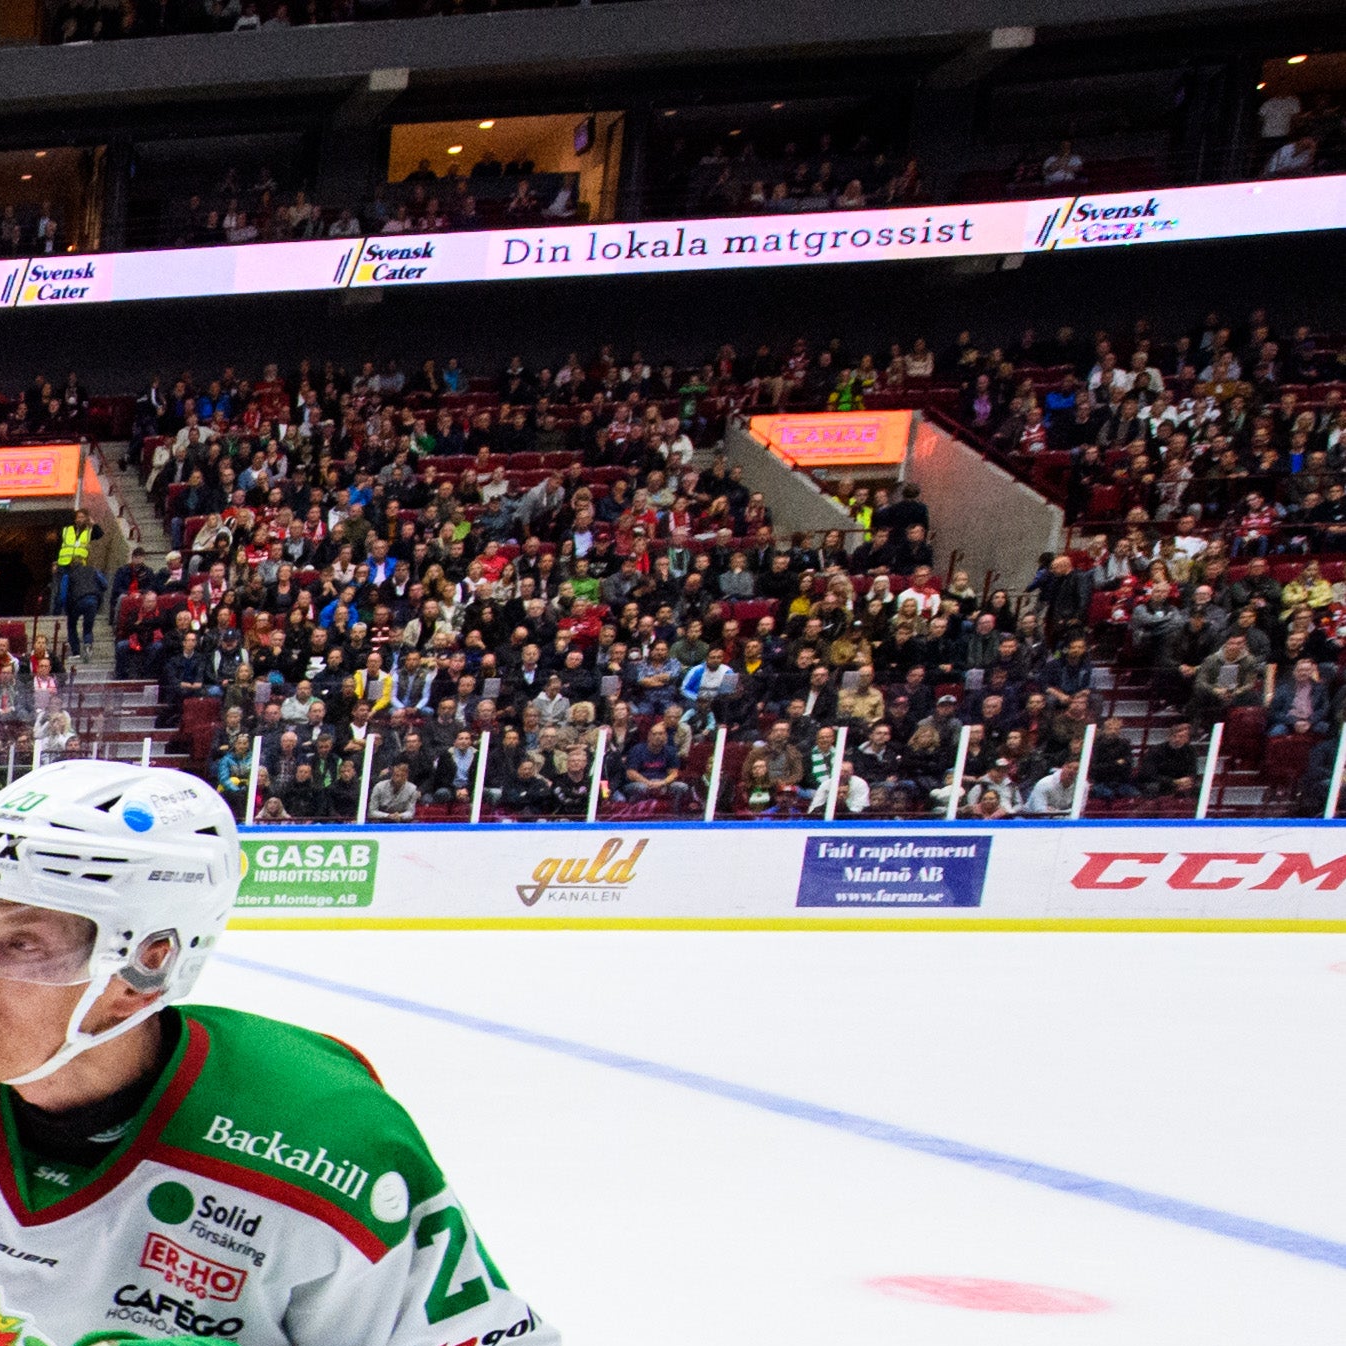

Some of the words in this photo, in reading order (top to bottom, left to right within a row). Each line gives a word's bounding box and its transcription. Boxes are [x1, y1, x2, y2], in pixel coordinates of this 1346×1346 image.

[1073, 198, 1159, 222] Svensk
[363, 242, 435, 261] Svensk
[503, 235, 571, 265] Din
[588, 228, 707, 260] lokala
[723, 217, 973, 257] matgrossist
[28, 264, 95, 283] Svensk
[372, 264, 427, 282] Cater
[37, 284, 89, 302] Cater
[2, 791, 49, 812] 20
[151, 789, 197, 809] Resurs
[255, 845, 371, 867] GASAB
[817, 842, 854, 858] Fait
[148, 869, 204, 884] BAUER
[254, 870, 368, 883] INBROTTSSKYDD
[516, 837, 649, 906] guld
[917, 866, 944, 882] AB
[1070, 852, 1346, 890] CCM
[236, 894, 271, 906] sters
[274, 894, 333, 908] Montage
[336, 894, 358, 906] AB
[548, 891, 621, 902] KANALEN
[202, 1115, 369, 1201] Backahill
[32, 1165, 72, 1188] SHL
[197, 1195, 261, 1238] Solid
[188, 1220, 266, 1268] Försäkring
[149, 1239, 238, 1294] ER-HO
[164, 1270, 207, 1300] BYGG
